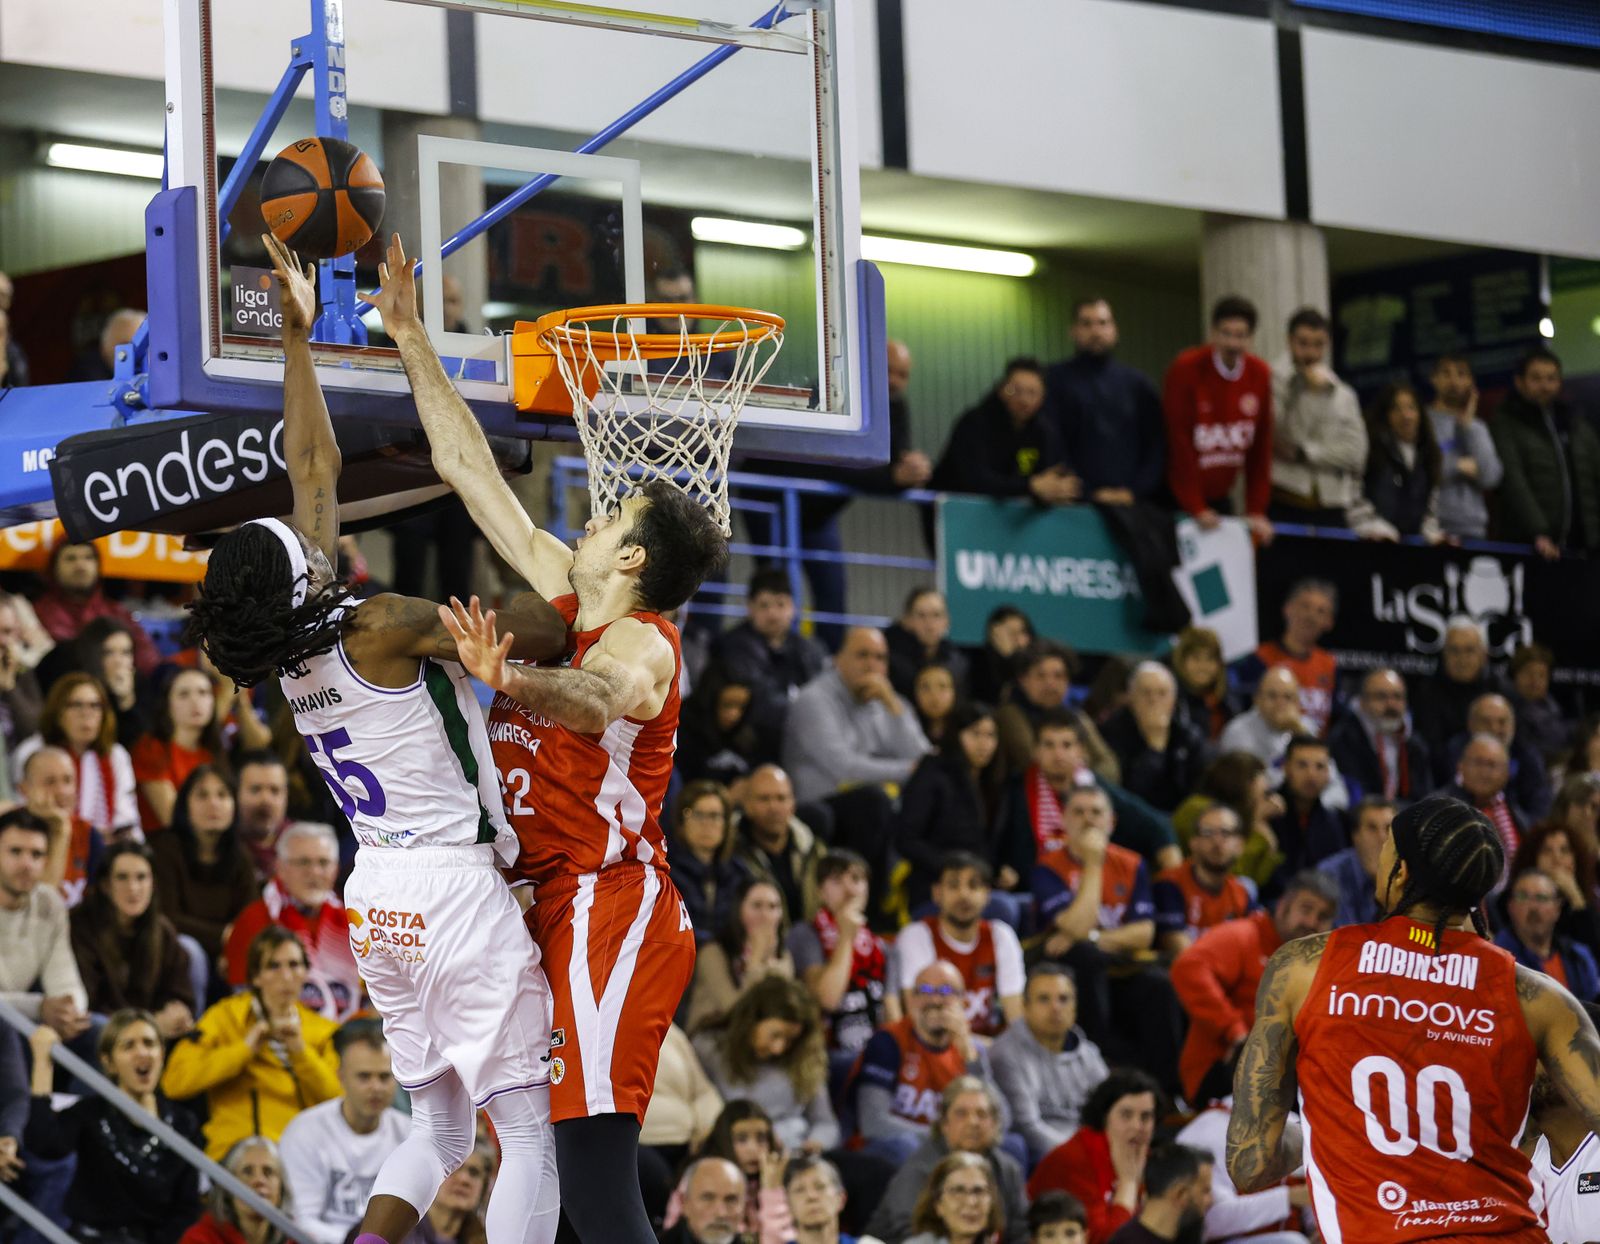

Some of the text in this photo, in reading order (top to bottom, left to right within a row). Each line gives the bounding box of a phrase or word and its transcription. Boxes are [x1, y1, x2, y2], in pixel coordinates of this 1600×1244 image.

[235, 284, 269, 308] liga
[22, 447, 56, 474] MO
[367, 907, 427, 930] COSTA
[391, 932, 426, 947] SOL
[1357, 940, 1479, 991] ROBINSON
[1328, 985, 1496, 1034] inmoovs
[1427, 1029, 1494, 1047] by AVINENT
[1351, 1055, 1474, 1163] 00
[1411, 1199, 1481, 1213] Manresa
[1391, 1208, 1500, 1231] Transforma
